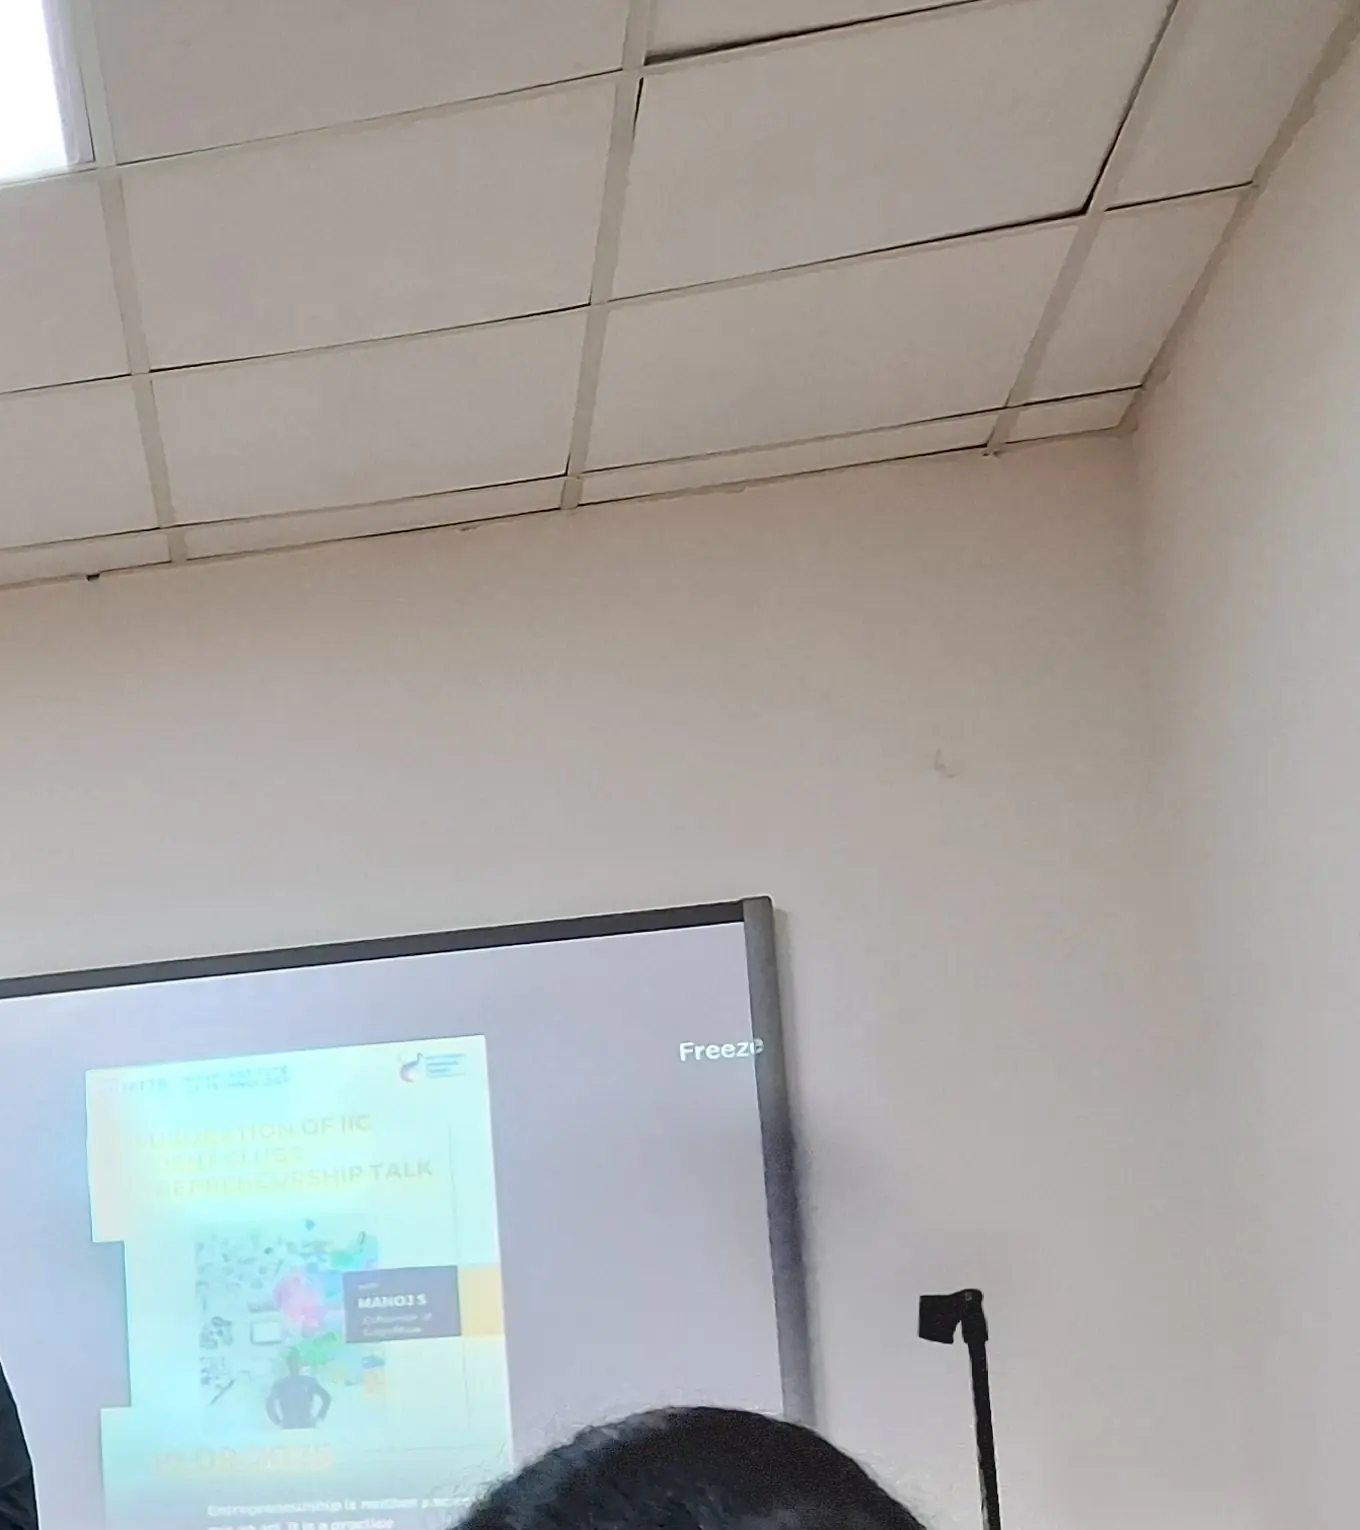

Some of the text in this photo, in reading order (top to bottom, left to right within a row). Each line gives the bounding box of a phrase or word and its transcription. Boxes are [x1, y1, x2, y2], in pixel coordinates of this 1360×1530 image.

[679, 1038, 764, 1061] Freeze
[301, 1115, 335, 1135] OF
[369, 1159, 434, 1180] TALK
